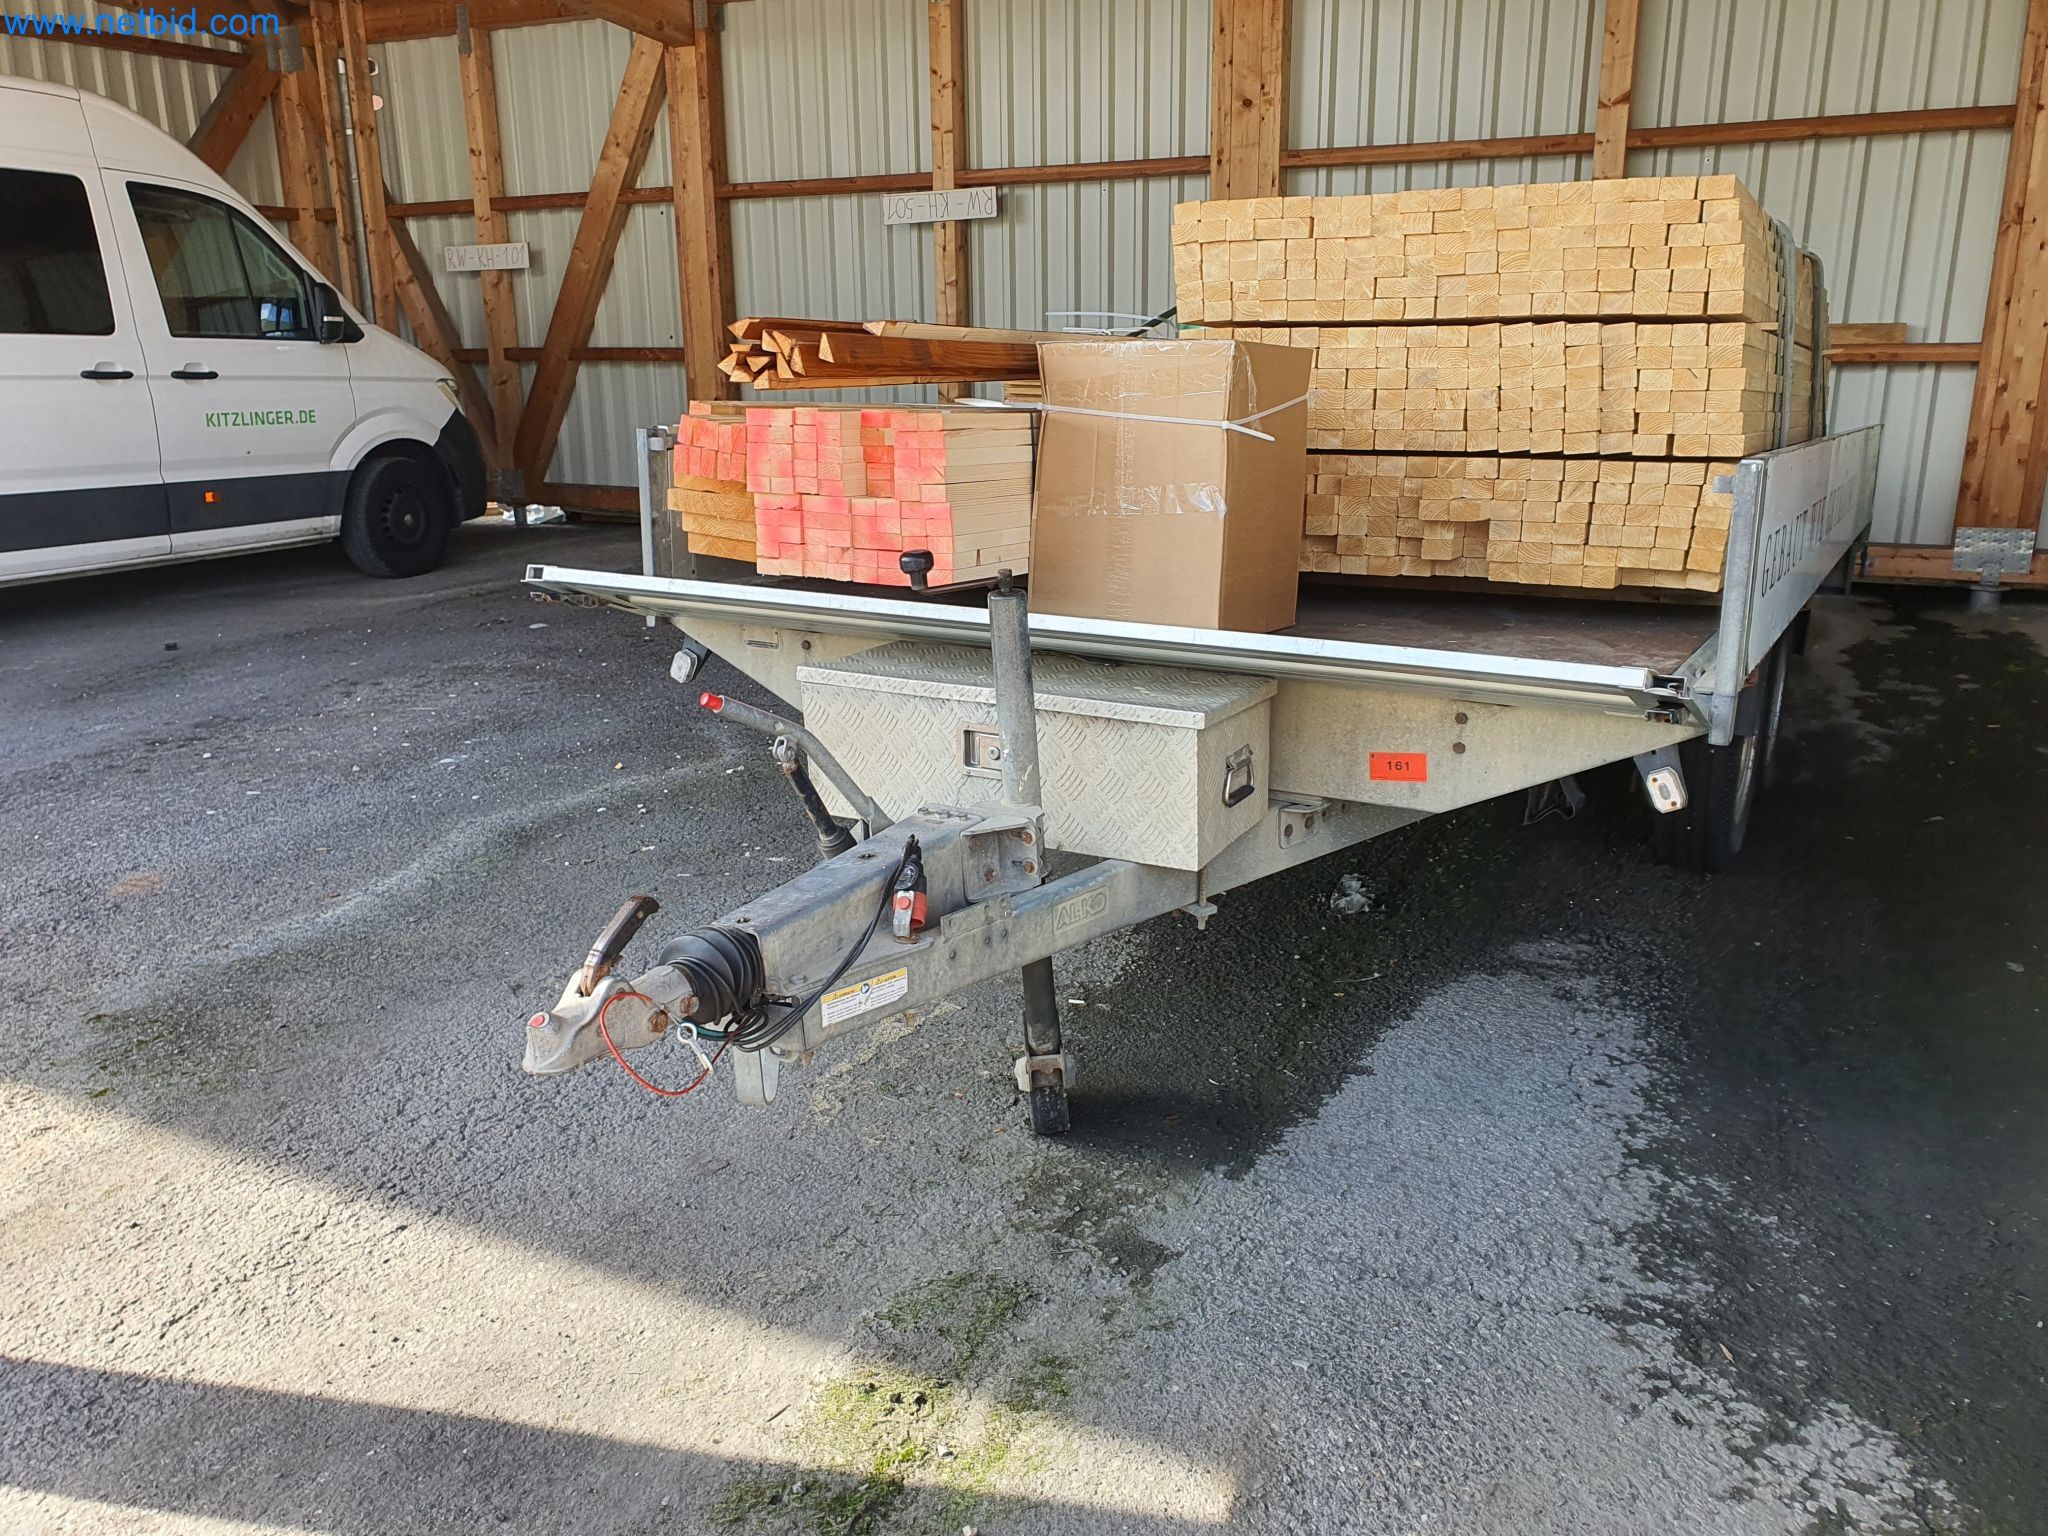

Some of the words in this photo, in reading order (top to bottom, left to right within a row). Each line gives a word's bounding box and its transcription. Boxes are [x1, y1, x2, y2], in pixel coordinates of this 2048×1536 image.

[887, 187, 994, 221] RW-KH-501
[446, 244, 526, 269] RW-KH-101
[205, 409, 317, 428] KITZLINGER.DE
[1761, 509, 1809, 598] GEBAUT
[1386, 760, 1410, 771] 161
